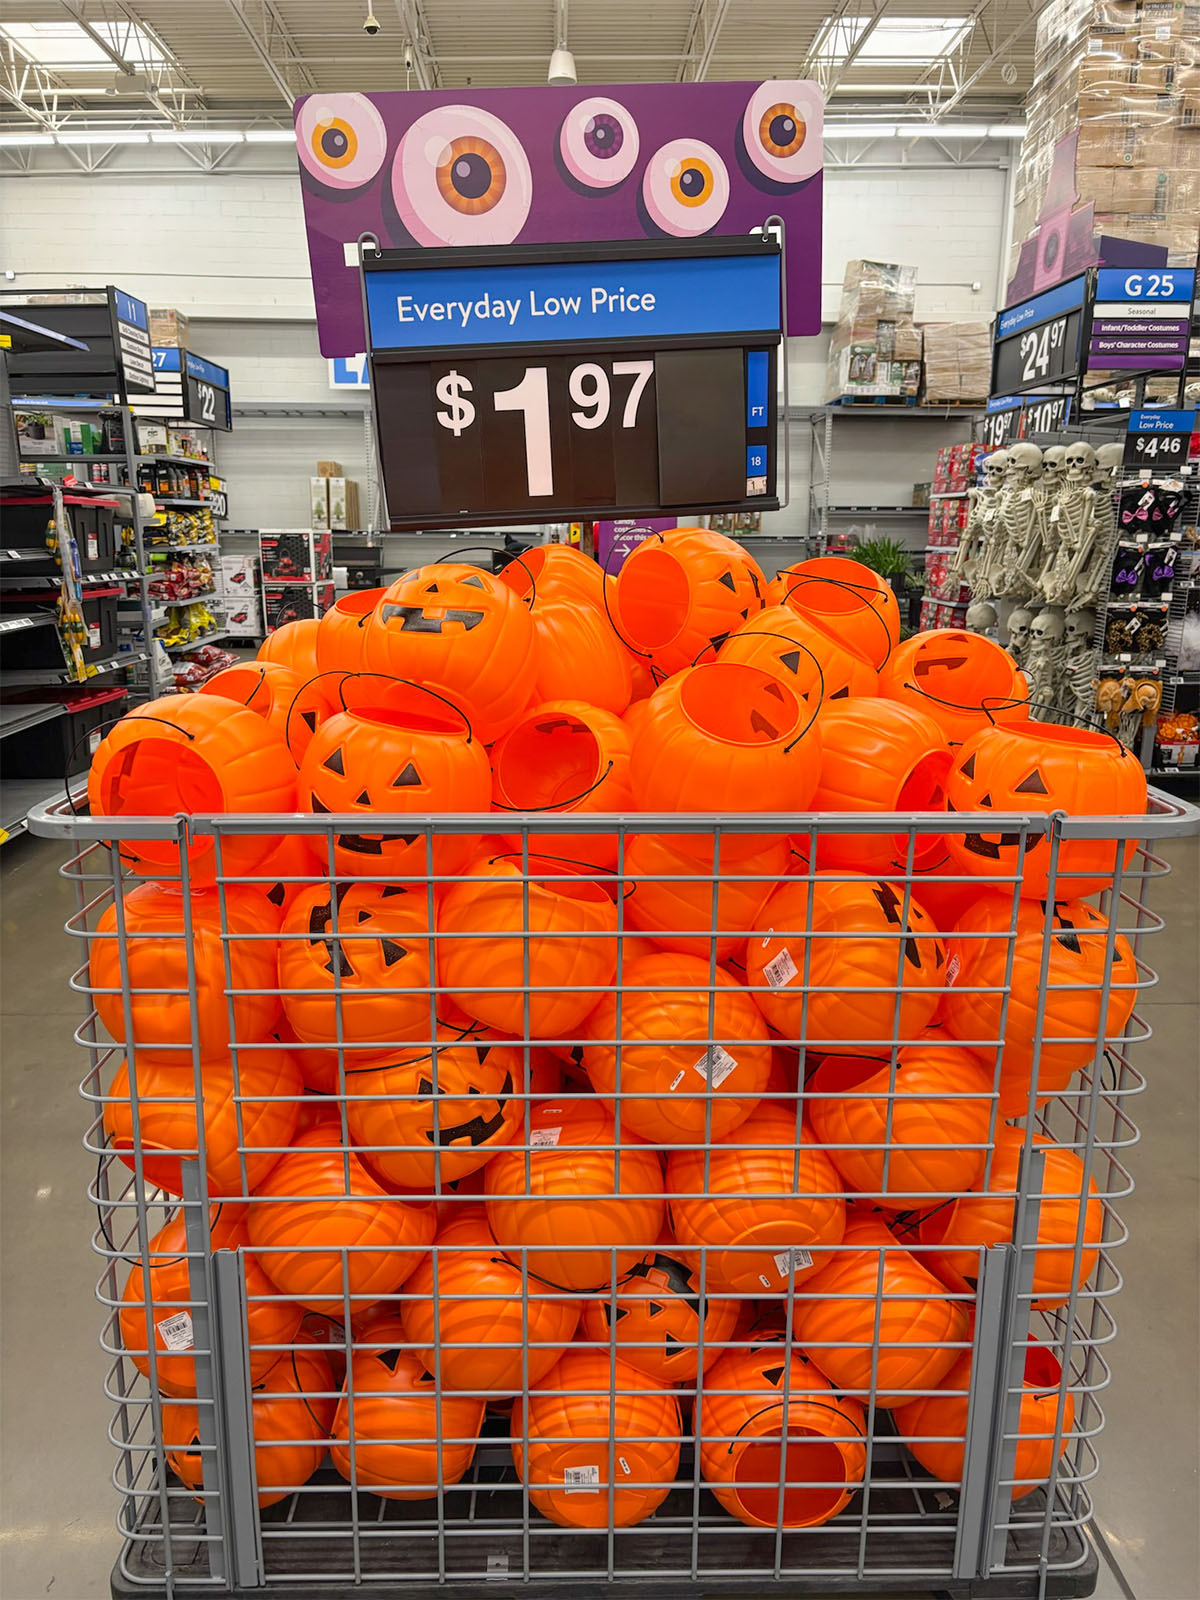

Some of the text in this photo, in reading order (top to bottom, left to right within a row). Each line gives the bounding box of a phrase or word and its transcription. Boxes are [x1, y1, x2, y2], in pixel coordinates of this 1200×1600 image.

[1124, 274, 1174, 297] G 25
[397, 286, 656, 328] Everyday Low Price
[1127, 307, 1157, 316] Seasonal
[1101, 324, 1180, 333] Infant/Toddler Costumes
[1116, 341, 1147, 349] Character
[1147, 341, 1179, 349] Costumes
[751, 406, 764, 417] FT
[1138, 420, 1174, 429] Low Price
[750, 456, 762, 466] 18
